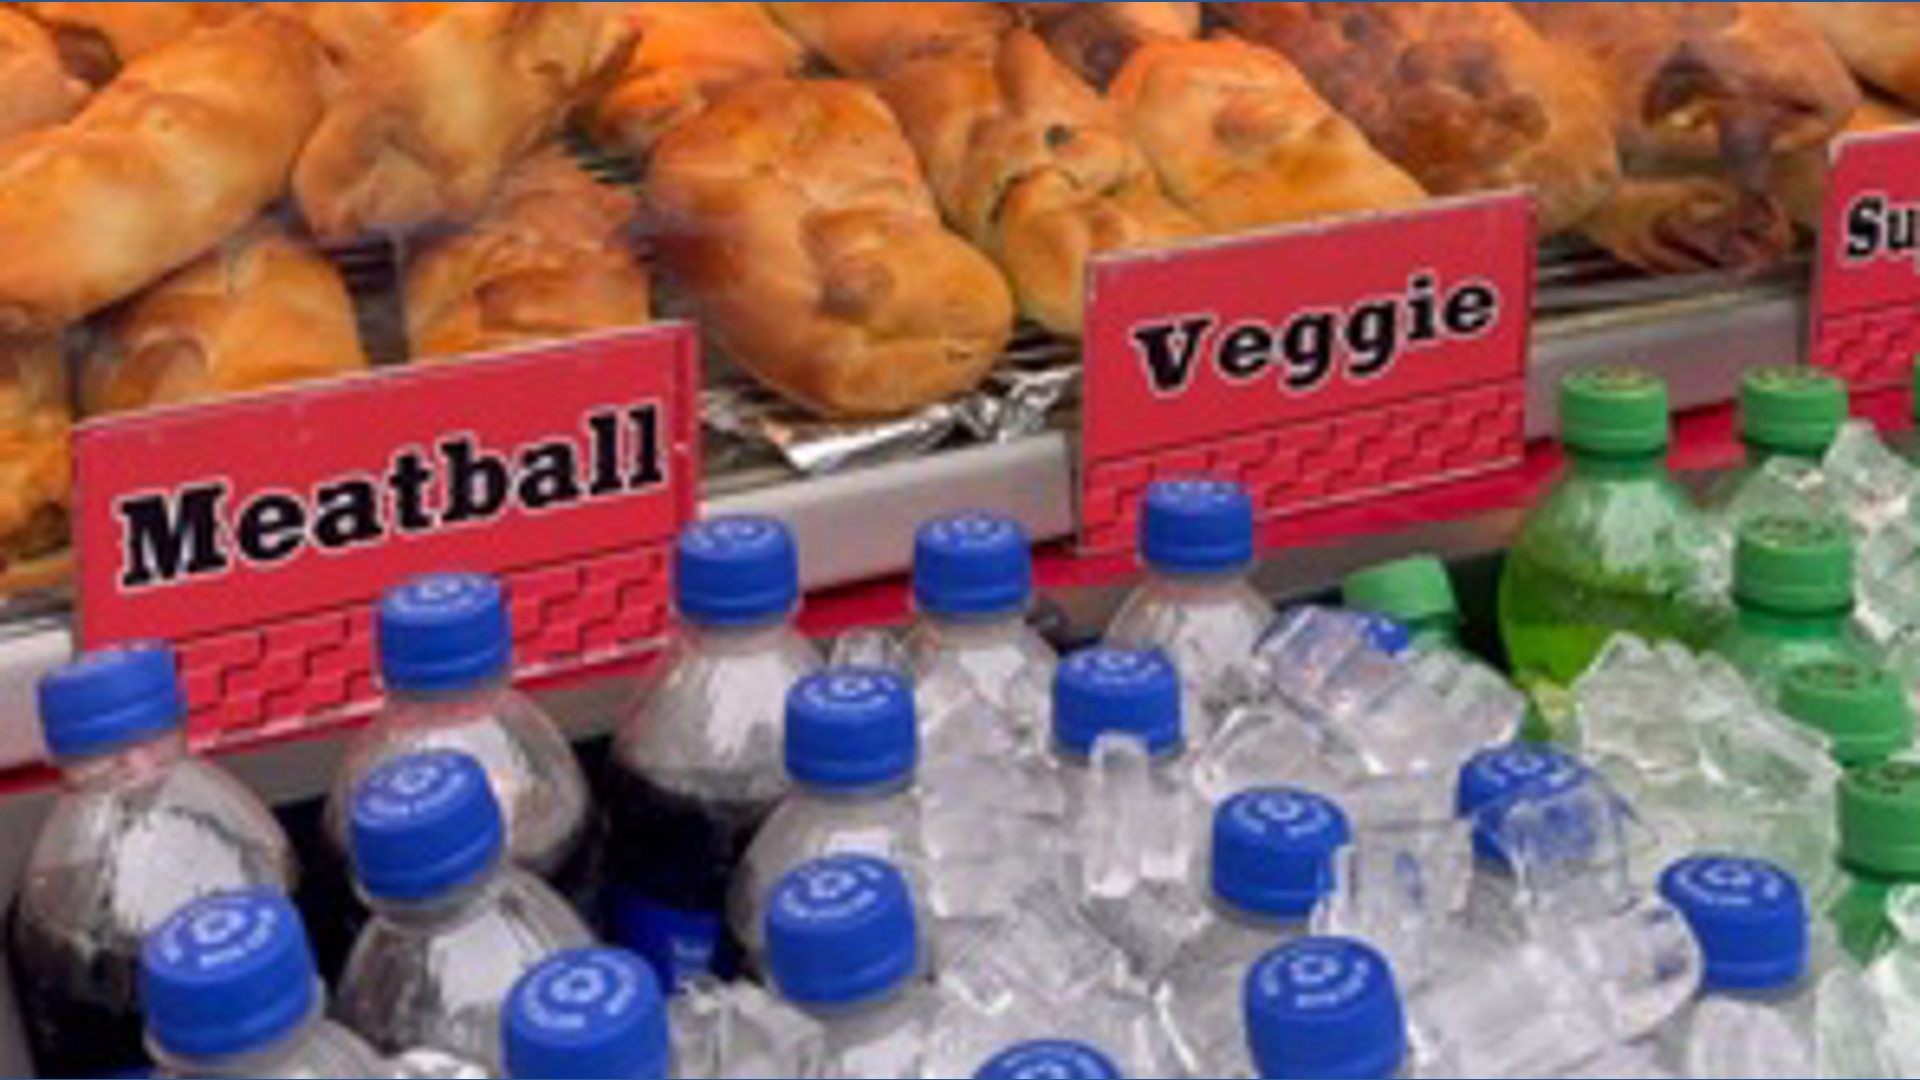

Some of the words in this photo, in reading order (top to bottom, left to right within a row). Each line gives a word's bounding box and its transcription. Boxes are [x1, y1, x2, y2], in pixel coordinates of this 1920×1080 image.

[1846, 192, 1920, 259] Su
[1133, 274, 1497, 391] Veggie
[118, 403, 665, 587] Meatball
